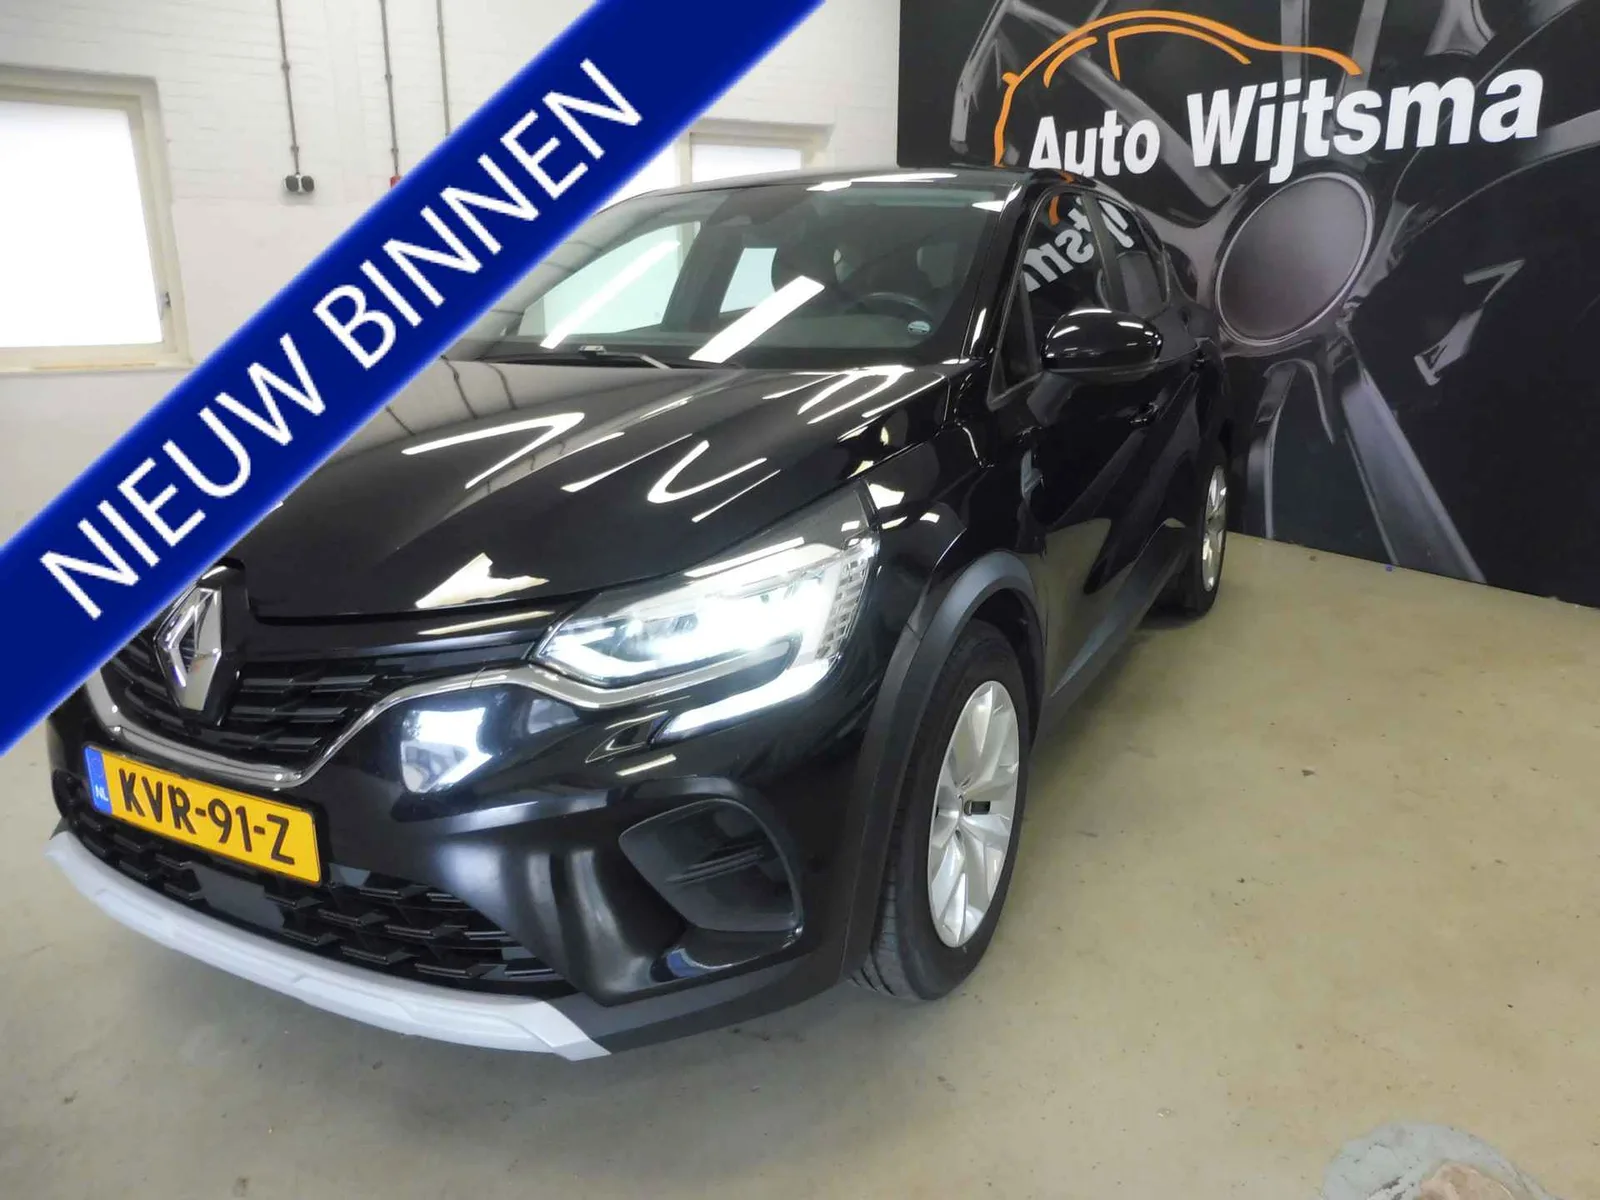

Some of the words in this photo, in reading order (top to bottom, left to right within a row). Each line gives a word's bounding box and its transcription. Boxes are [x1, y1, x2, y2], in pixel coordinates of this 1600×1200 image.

[1028, 109, 1161, 177] Auto
[1187, 69, 1544, 184] Wijtsma
[94, 784, 109, 802] NL
[118, 768, 295, 866] KVR-91-Z
